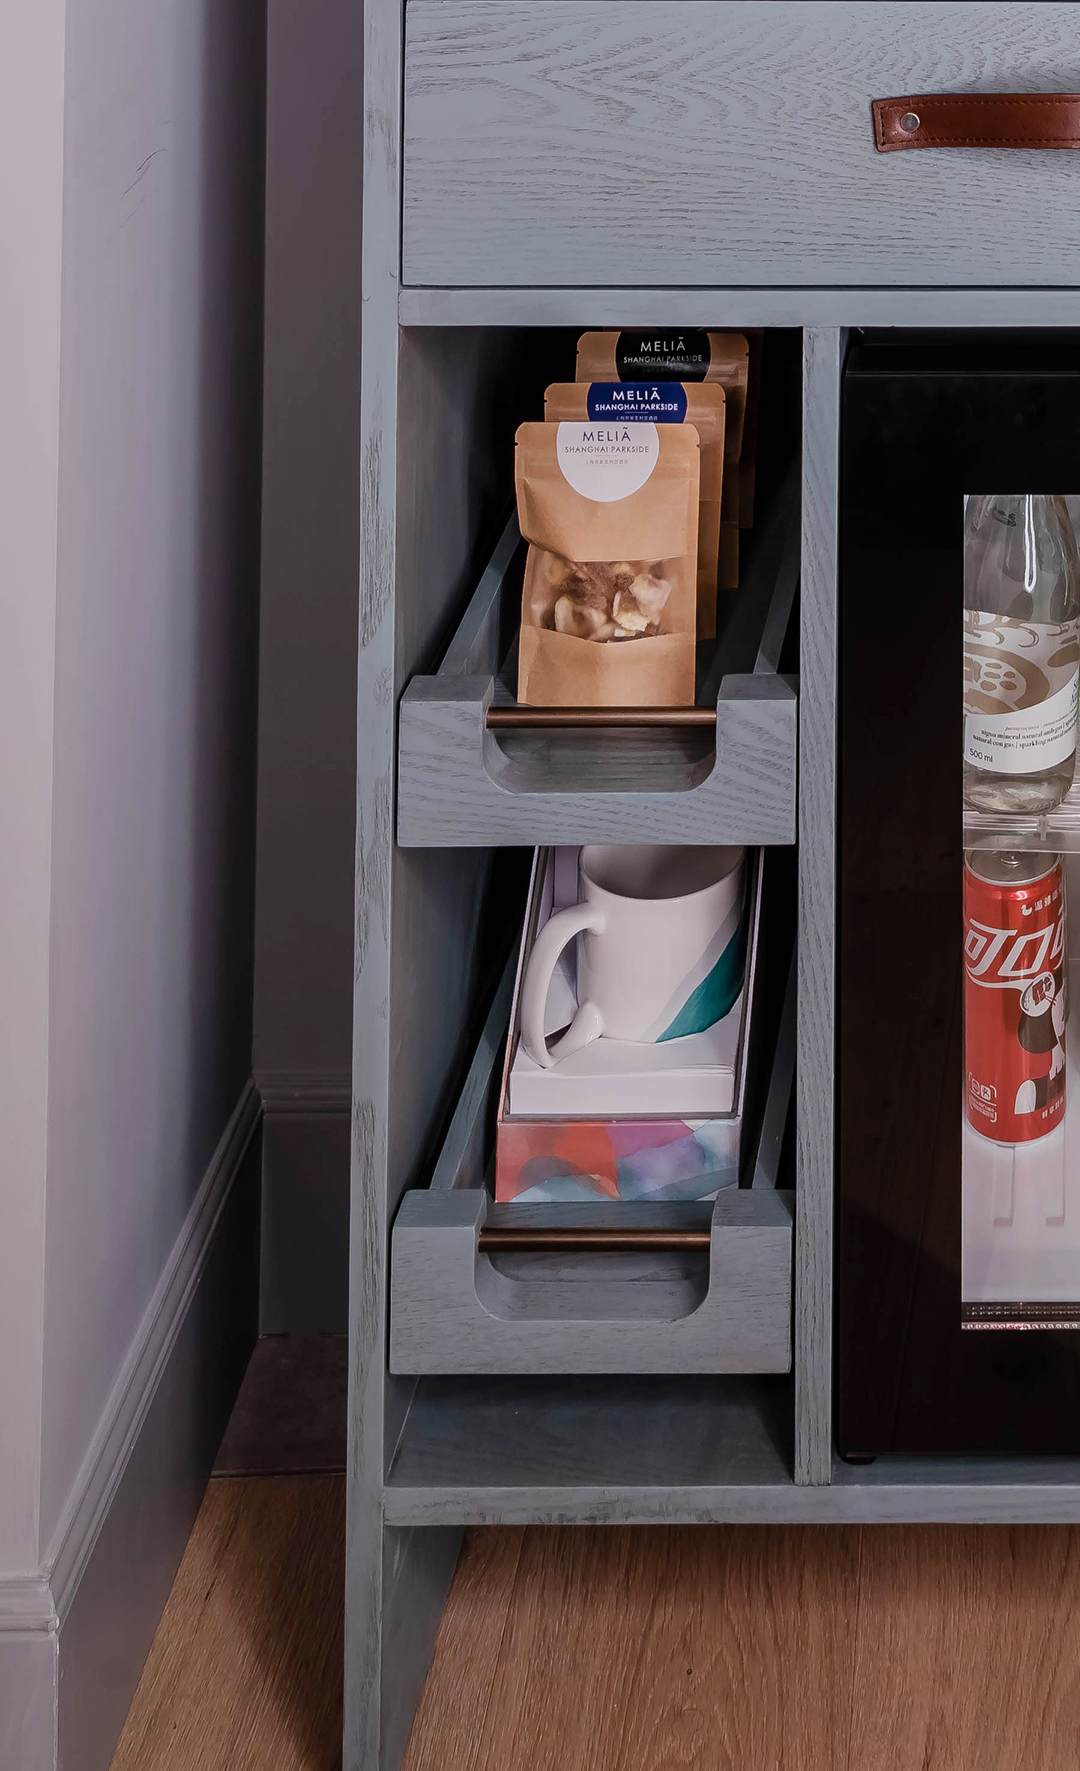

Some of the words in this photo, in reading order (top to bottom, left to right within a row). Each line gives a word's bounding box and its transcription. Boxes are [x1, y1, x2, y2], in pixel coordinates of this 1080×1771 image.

[623, 356, 664, 364] SHANGHAI
[667, 354, 702, 362] PARKSIDE
[595, 403, 638, 411] SHANGHAI
[640, 403, 679, 411] PARKSIDE
[1022, 731, 1042, 740] natural
[973, 734, 992, 745] natural
[1020, 738, 1047, 749] sparkling
[970, 748, 983, 759] 500
[984, 755, 993, 763] ml
